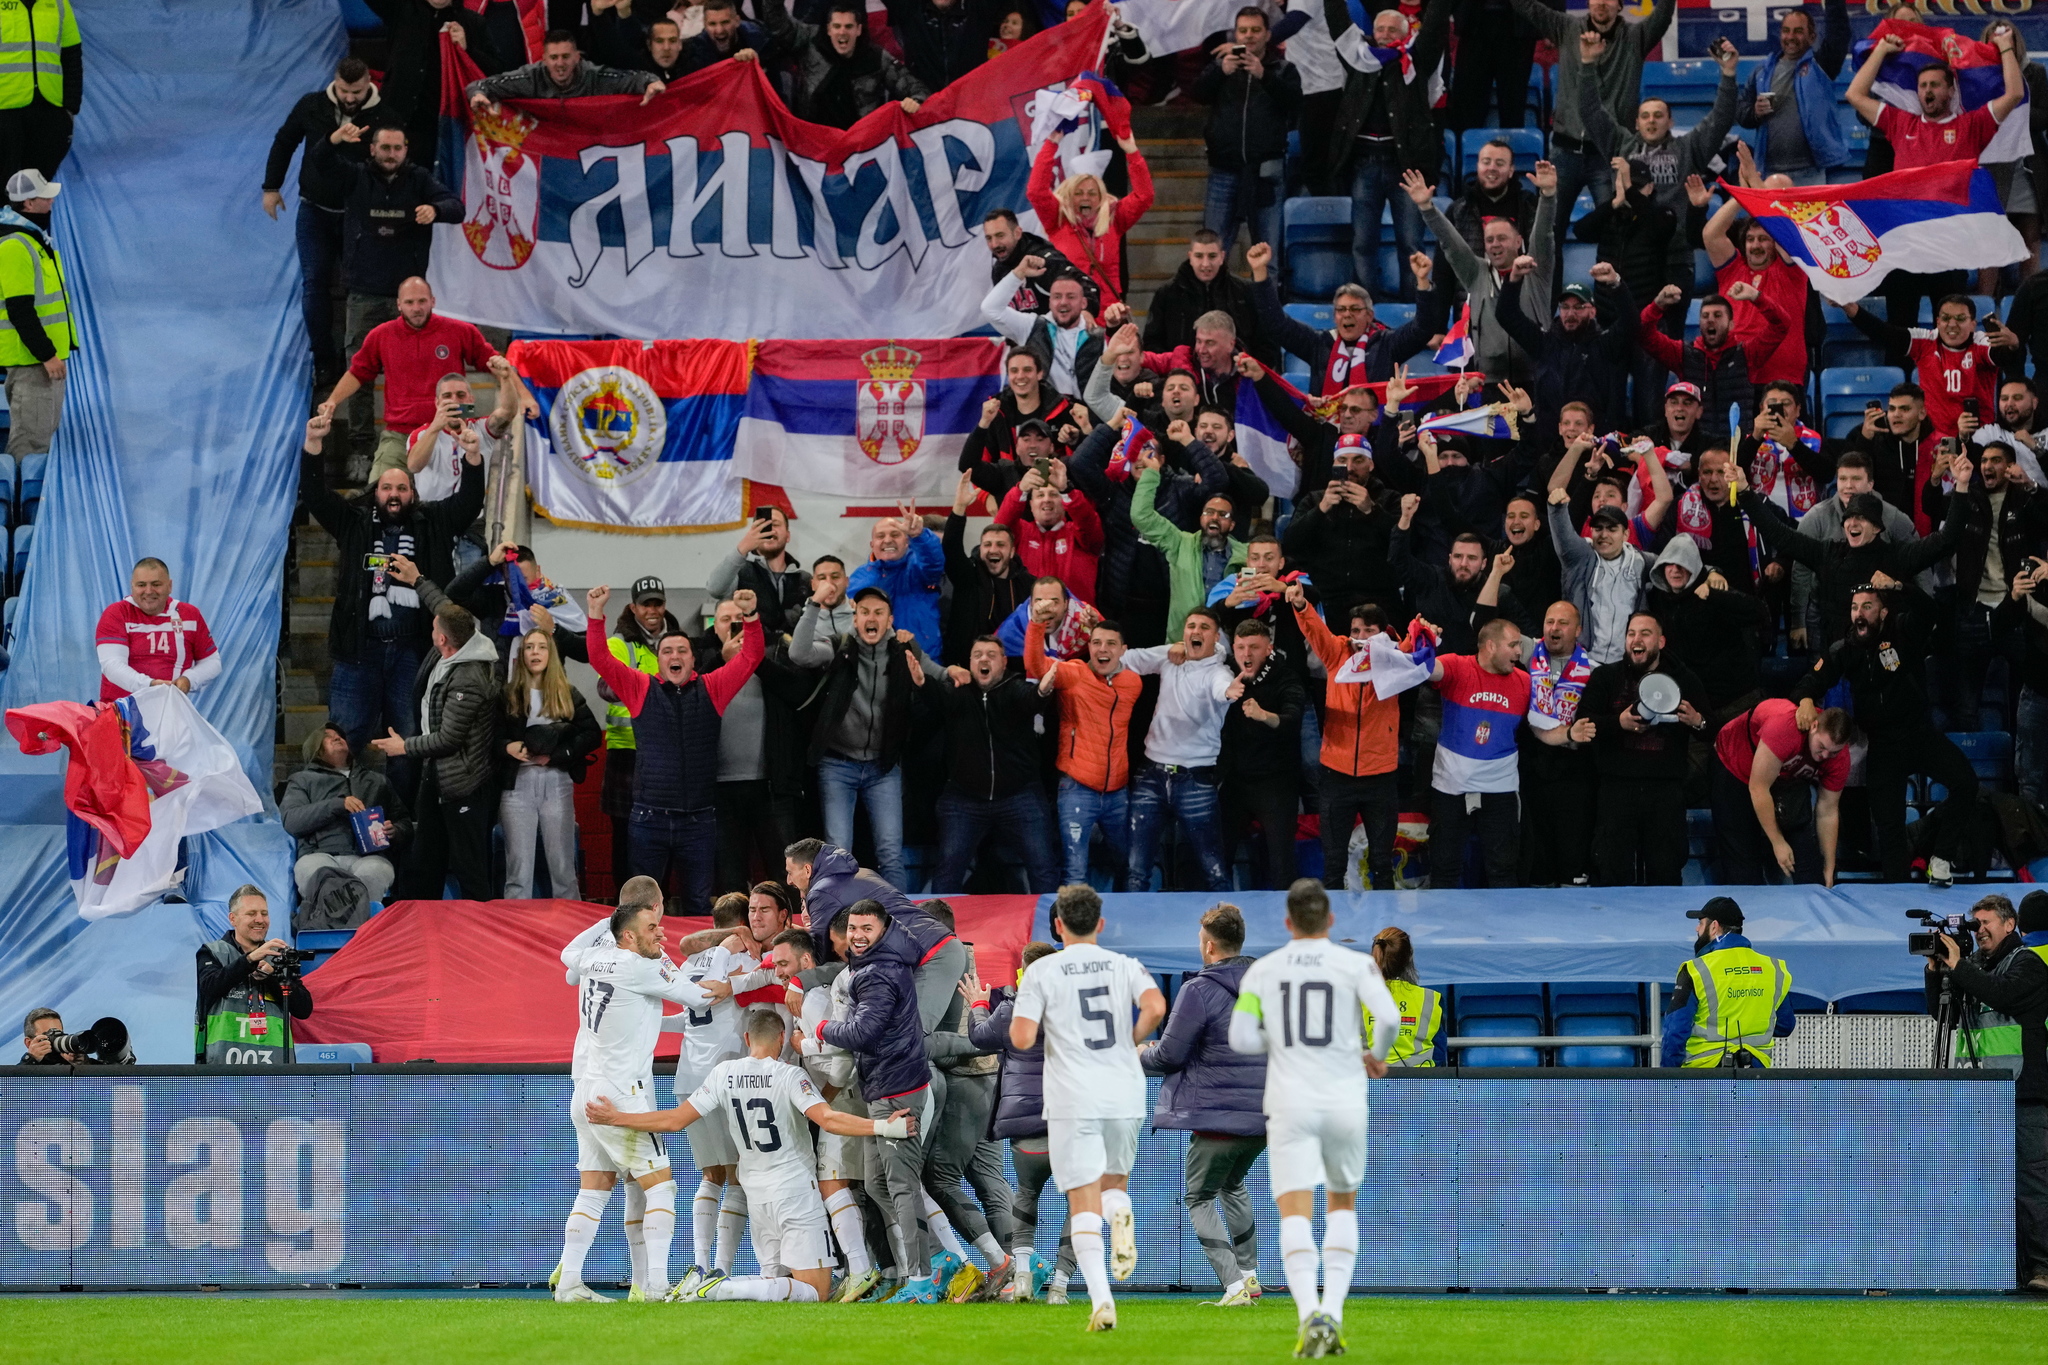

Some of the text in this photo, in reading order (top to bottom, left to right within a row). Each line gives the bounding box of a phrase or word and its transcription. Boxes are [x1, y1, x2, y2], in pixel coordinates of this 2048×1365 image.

[1, 1, 19, 11] 307
[1943, 369, 1961, 393] 10
[636, 579, 663, 593] ICON
[146, 631, 170, 654] 14
[1469, 691, 1509, 709] СРБИЈА
[1724, 966, 1750, 976] PSS
[1727, 985, 1764, 1000] Supervisor
[582, 978, 615, 1034] 17
[1280, 981, 1333, 1047] 10
[1078, 986, 1116, 1050] 5
[319, 1052, 336, 1060] 465
[728, 1075, 735, 1089] S.
[731, 1098, 782, 1152] 13
[15, 1084, 347, 1273] slag
